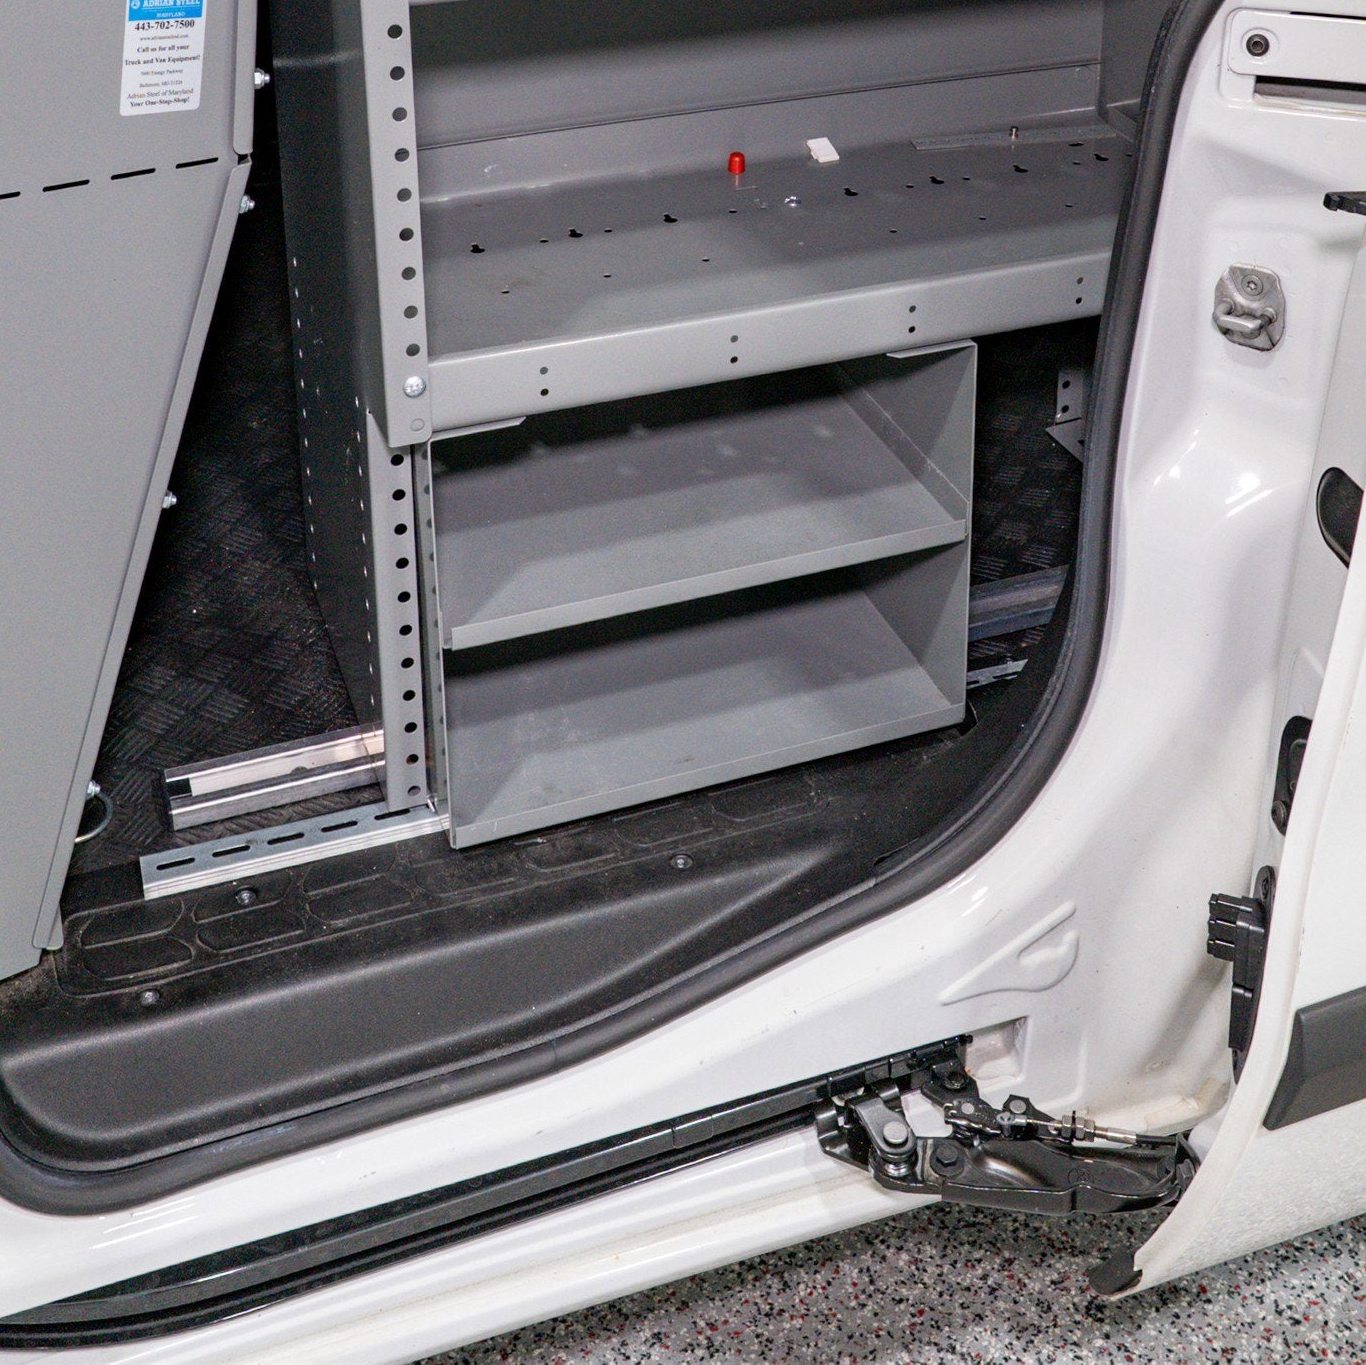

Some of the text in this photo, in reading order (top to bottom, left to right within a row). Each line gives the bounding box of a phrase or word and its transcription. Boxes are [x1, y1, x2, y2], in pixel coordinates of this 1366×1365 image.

[143, 0, 174, 7] ADRIAN
[135, 20, 195, 31] 443-702-7500
[169, 88, 193, 96] Maryland
